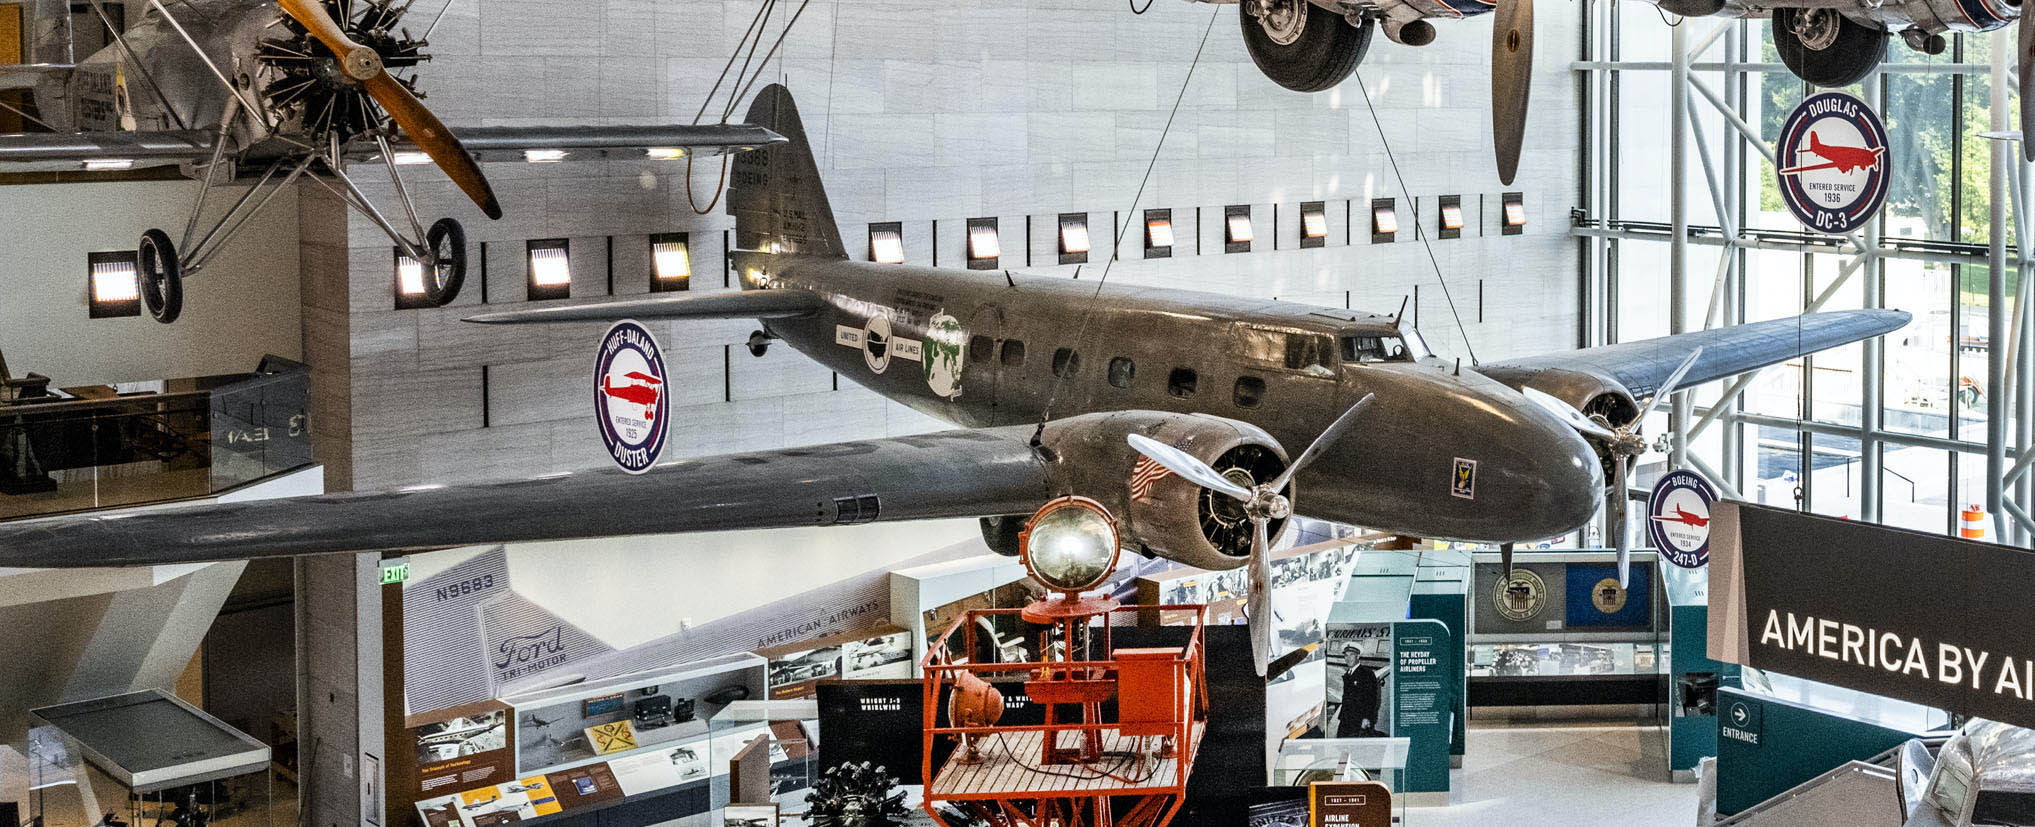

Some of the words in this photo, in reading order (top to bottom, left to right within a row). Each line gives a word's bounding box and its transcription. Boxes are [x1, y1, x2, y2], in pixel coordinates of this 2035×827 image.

[1808, 98, 1858, 118] DOUGLAS
[1809, 182, 1833, 191] ENTERED
[1833, 183, 1856, 192] SERVICE
[1824, 192, 1841, 203] 1936
[1815, 210, 1848, 229] DC-3
[606, 328, 655, 360] HUFF-DALAND
[840, 330, 858, 342] UNITED
[895, 343, 904, 352] AIR
[905, 344, 919, 355] LINES
[615, 415, 631, 426] ENTERED
[631, 418, 647, 429] SERVICE
[614, 440, 649, 468] DUSTER
[1671, 475, 1698, 489] BOEING
[1680, 540, 1692, 548] 1934
[1686, 533, 1701, 541] SERVICE
[1672, 551, 1698, 566] 247-D
[384, 567, 405, 582] EXIT
[436, 574, 494, 602] N9683
[757, 619, 821, 649] AMERICAN
[829, 600, 879, 625] AIRWAYS
[495, 626, 566, 670] Ford
[1760, 608, 1930, 680] AMERICA
[1938, 641, 1989, 690] BY
[1994, 656, 2035, 702] AI
[502, 653, 567, 681] TRI-MOTOR
[1722, 727, 1758, 745] ENTRANCE
[1324, 814, 1350, 822] AIRLINE
